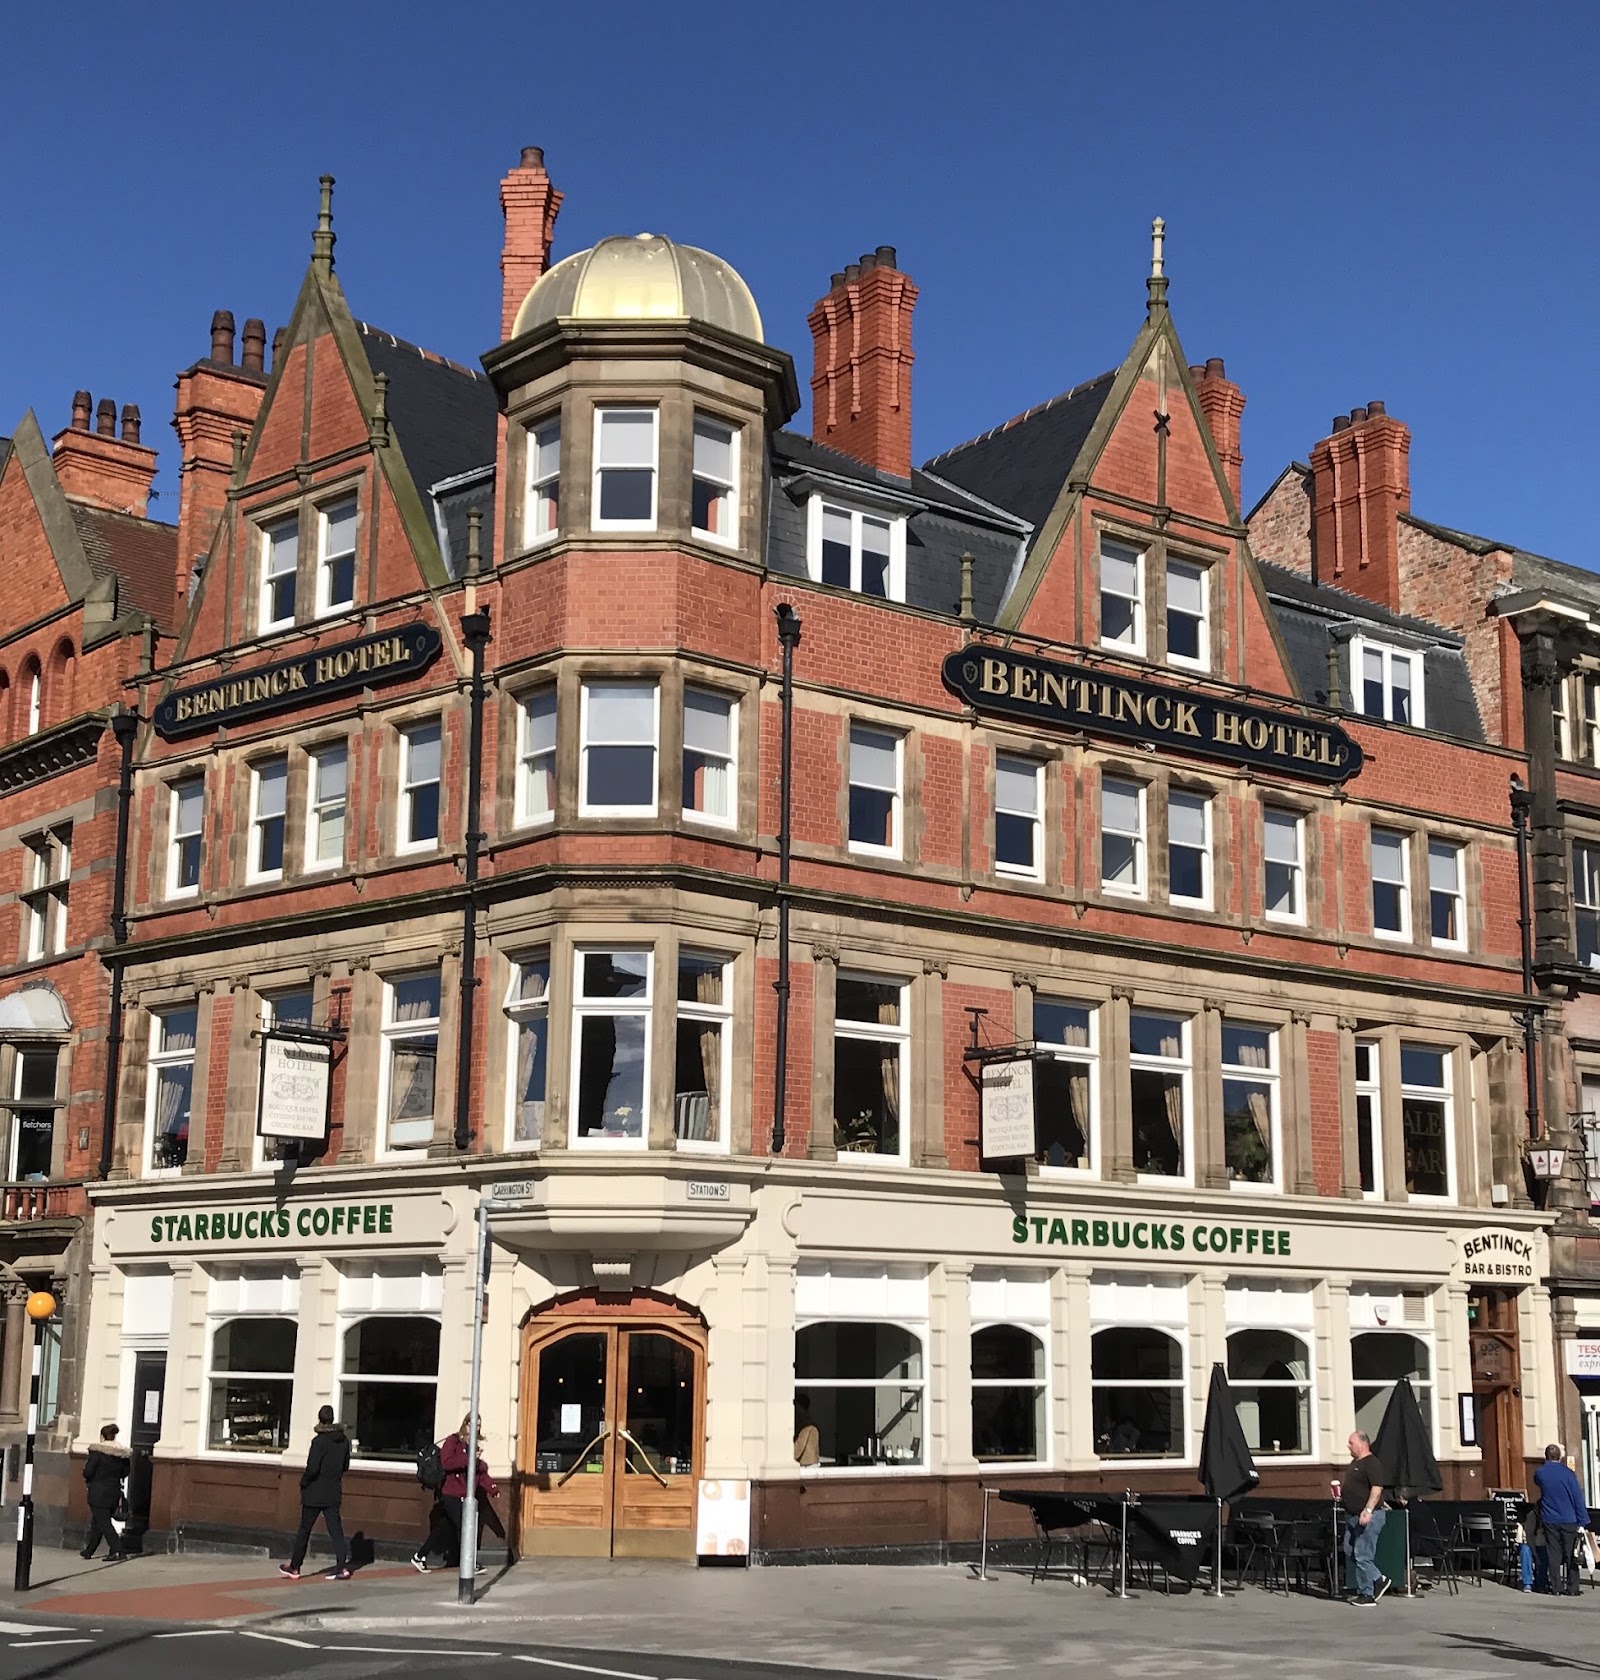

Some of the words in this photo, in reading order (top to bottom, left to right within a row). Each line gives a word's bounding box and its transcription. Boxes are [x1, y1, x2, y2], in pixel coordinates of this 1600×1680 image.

[174, 662, 307, 722] BENTINCK
[314, 636, 410, 685] HOTEL
[979, 656, 1202, 737] BENTINCK
[1212, 708, 1341, 767] HOTEL
[270, 1044, 325, 1061] BENTINCK
[278, 1058, 316, 1071] HOTEL
[985, 1065, 1031, 1079] BENTINCK
[992, 1079, 1024, 1092] HOTEL
[299, 1106, 319, 1114] HOTEL
[271, 1121, 301, 1130] COCKTAIL
[1405, 1109, 1441, 1137] ALE
[690, 1183, 718, 1196] STATION
[150, 1209, 290, 1243] STARBUCKS
[296, 1204, 393, 1237] COFFEE
[1012, 1215, 1185, 1251] STARBUCKS
[1192, 1226, 1291, 1256] COFFEE
[1463, 1234, 1532, 1261] BENTINCK
[1464, 1262, 1485, 1275] BAR
[1487, 1264, 1493, 1275] &
[1495, 1263, 1532, 1276] BISTRO
